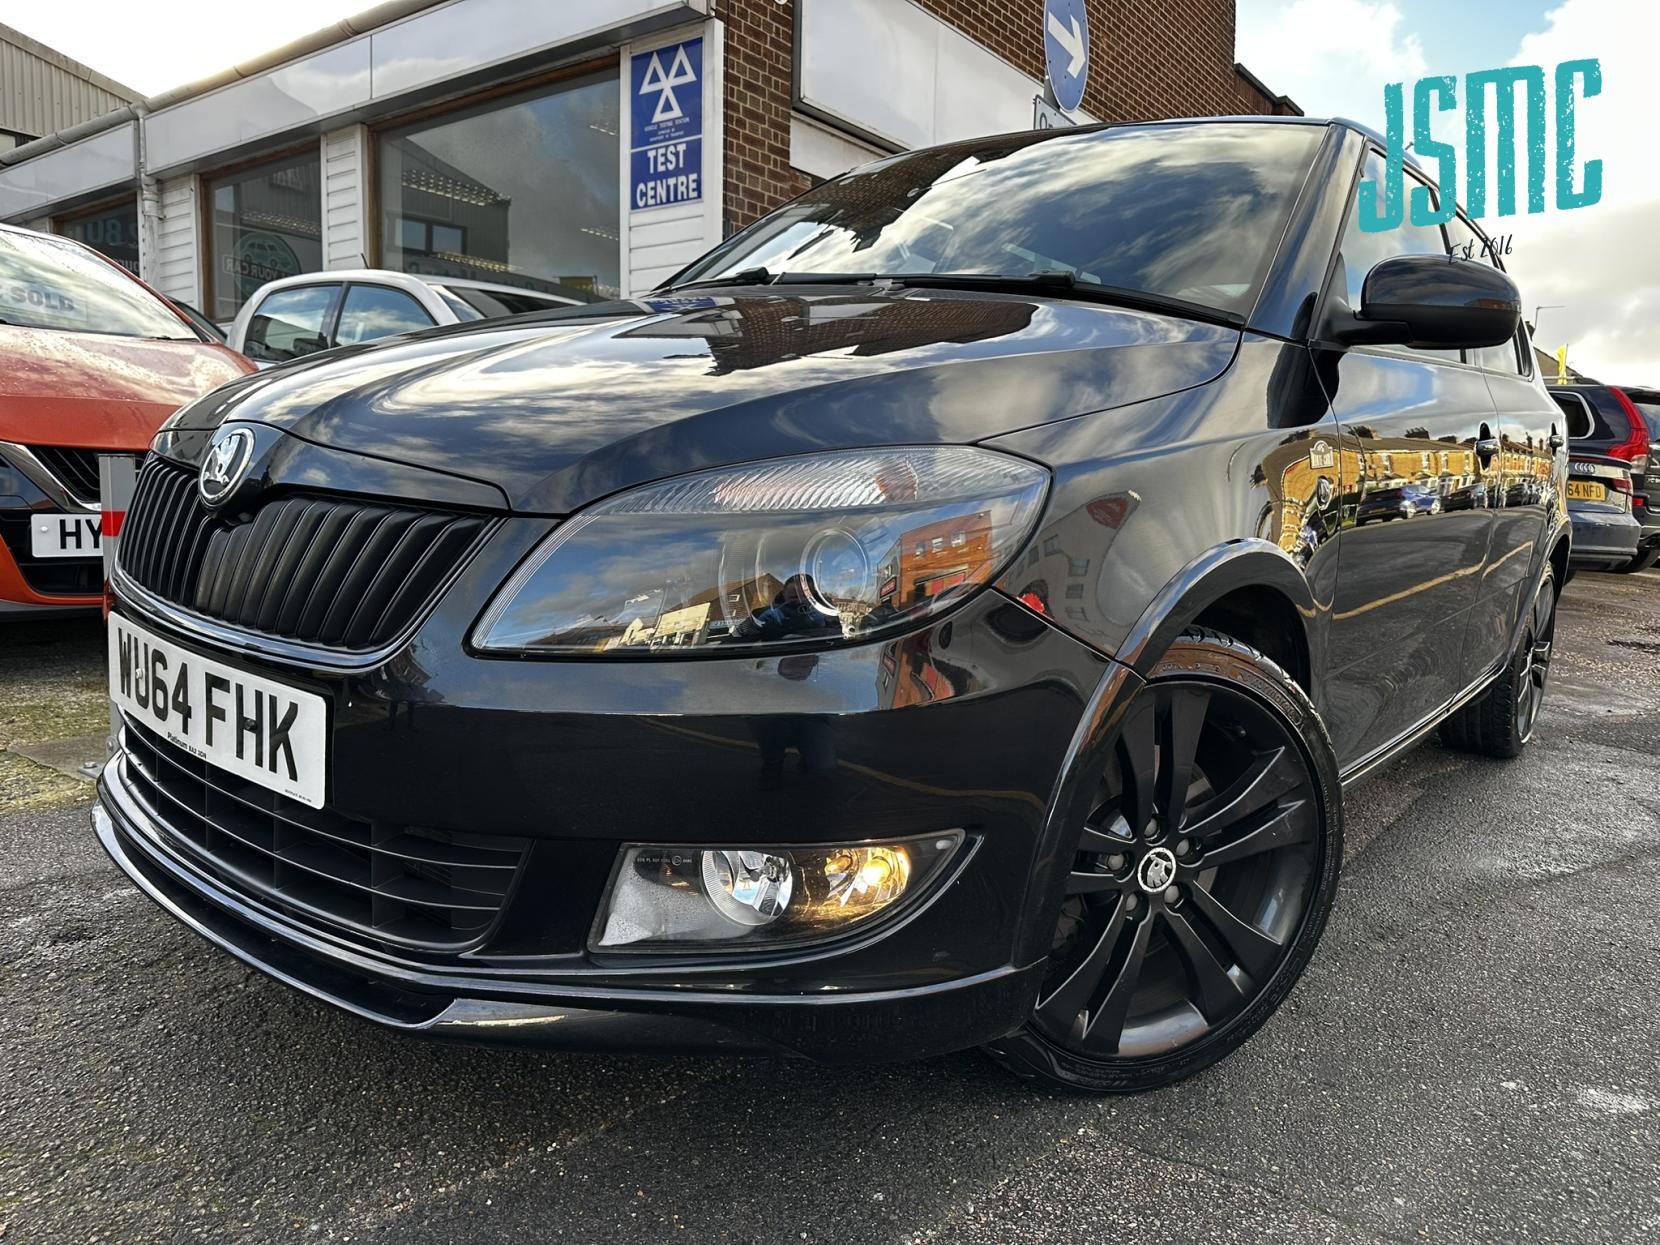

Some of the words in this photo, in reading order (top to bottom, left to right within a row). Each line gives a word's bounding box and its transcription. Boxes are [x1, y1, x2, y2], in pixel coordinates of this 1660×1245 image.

[647, 143, 687, 174] TEST
[636, 173, 698, 207] CENTRE
[10, 286, 74, 311] SOLD
[1567, 483, 1580, 496] 64
[118, 627, 192, 736] WU64
[205, 671, 299, 783] FHK
